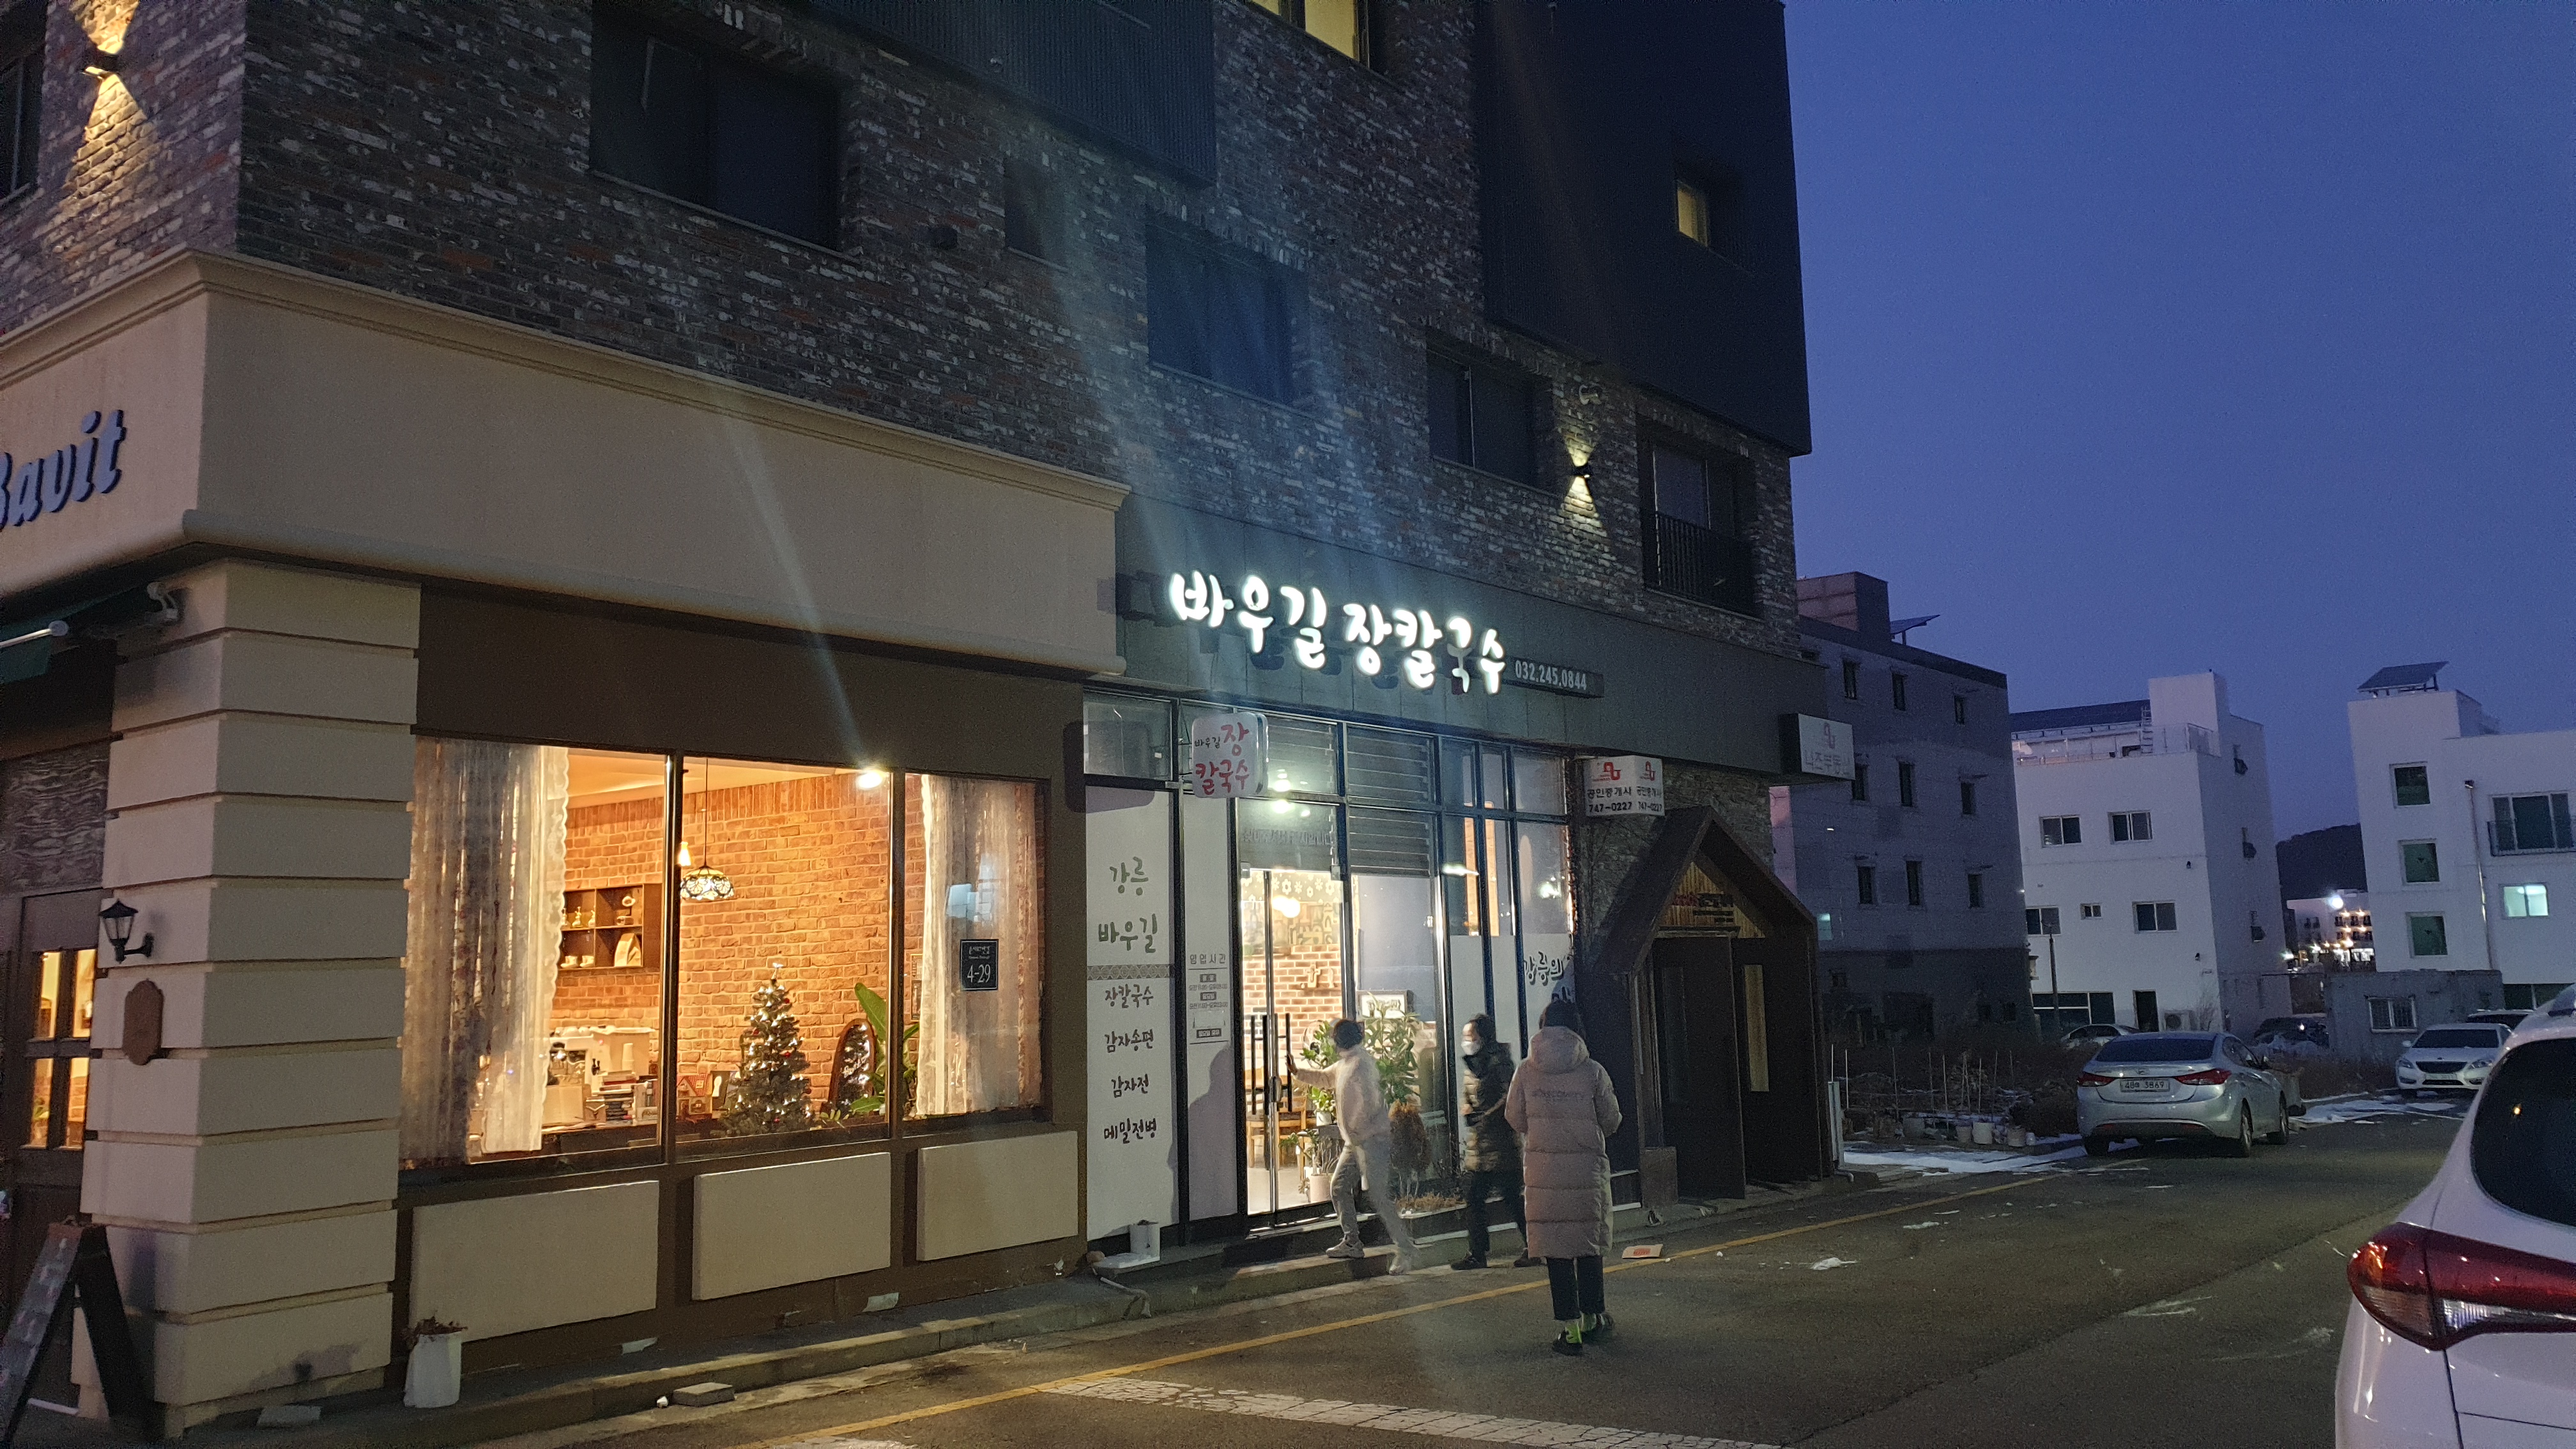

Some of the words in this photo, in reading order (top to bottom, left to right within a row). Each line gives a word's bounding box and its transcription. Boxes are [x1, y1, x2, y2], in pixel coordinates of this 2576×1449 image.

[1169, 570, 1328, 670] 바우길
[1342, 602, 1506, 694] 장칼국수
[1515, 660, 1586, 691] 032.245.0844
[1220, 722, 1250, 756] 장
[1195, 759, 1250, 795] 칼국수
[1587, 786, 1632, 799] 공인중개사
[1588, 801, 1632, 813] 747-0227
[1110, 856, 1149, 896] 강릉
[1098, 914, 1158, 953] 바우길
[967, 964, 991, 983] 4-29
[1105, 984, 1154, 1009] 장칼국수
[1105, 1029, 1154, 1053] 감자송편
[1111, 1074, 1149, 1098] 감자전
[1104, 1118, 1157, 1144] 메밀전병
